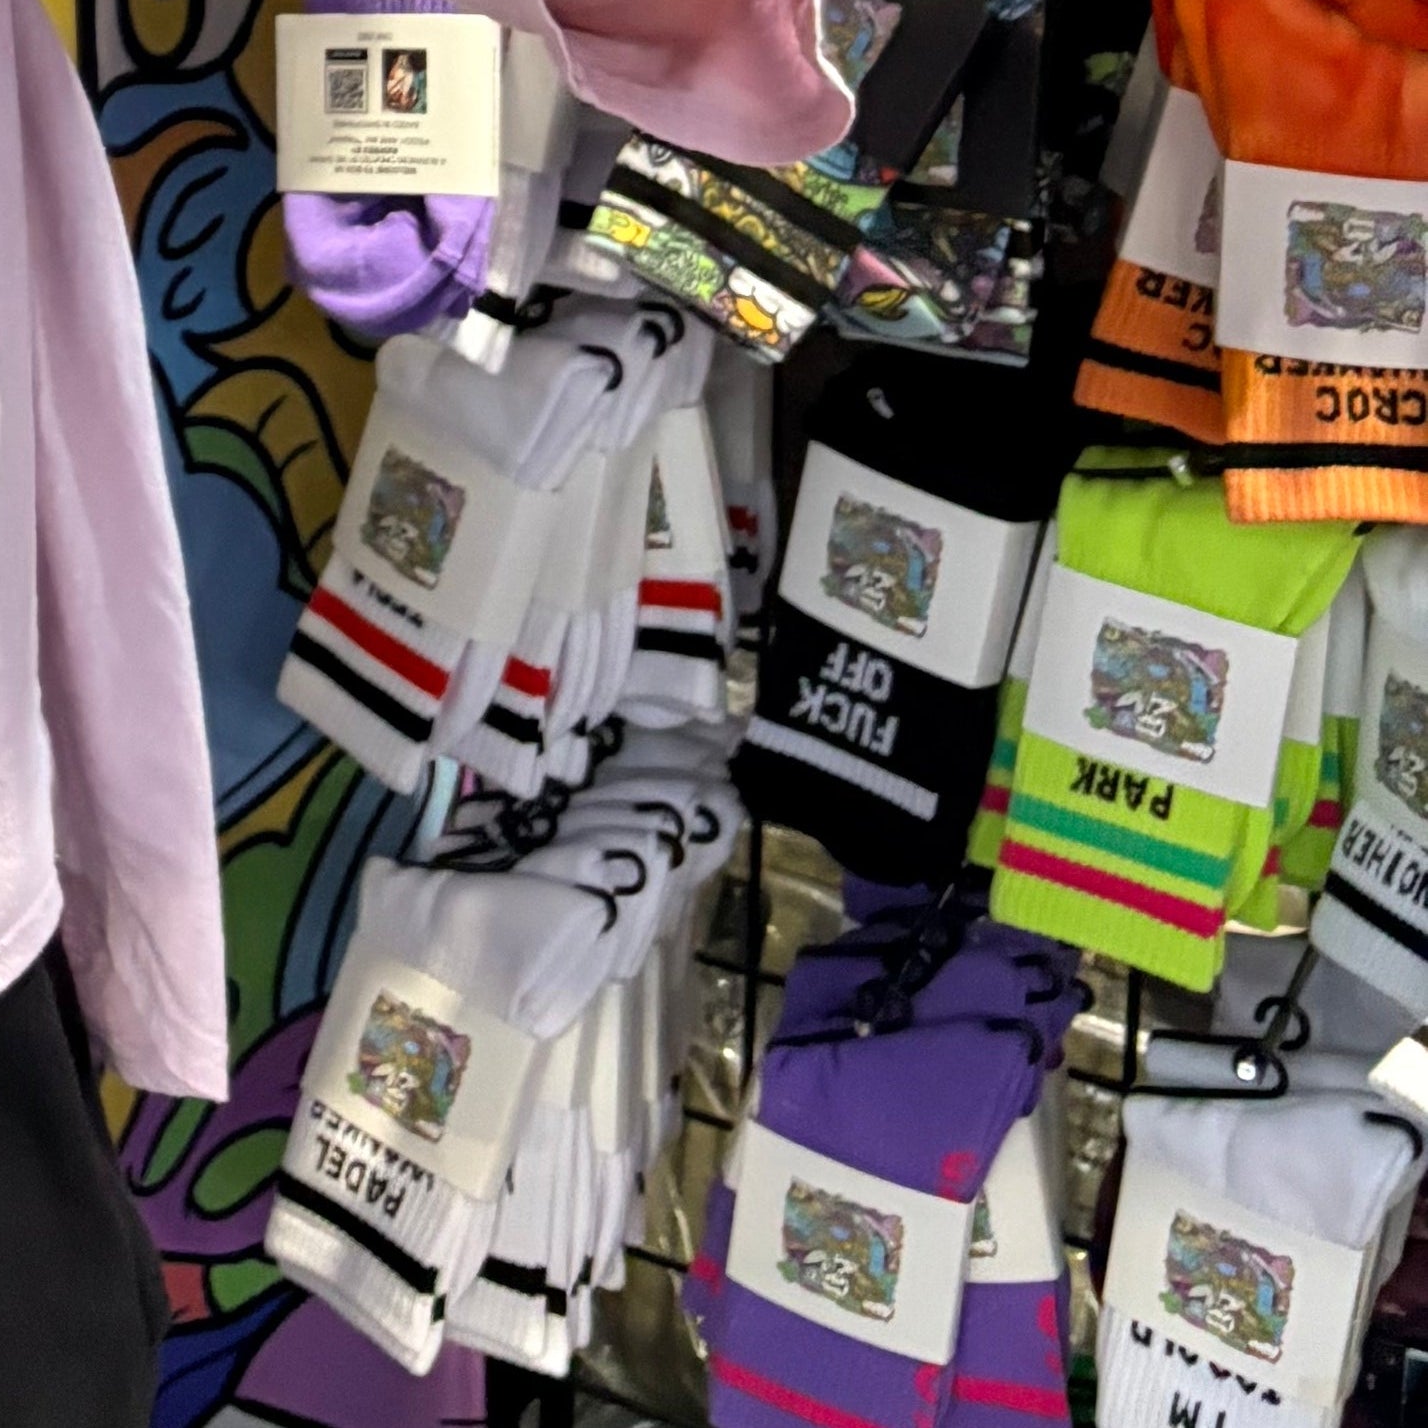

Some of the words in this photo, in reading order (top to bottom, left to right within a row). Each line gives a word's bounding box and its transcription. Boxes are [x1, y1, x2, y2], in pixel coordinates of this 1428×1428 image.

[1315, 384, 1428, 426] CROC
[819, 642, 894, 699] OFF
[788, 676, 901, 758] FUCK
[1069, 754, 1175, 822] PARK
[315, 1135, 407, 1221] PADEL
